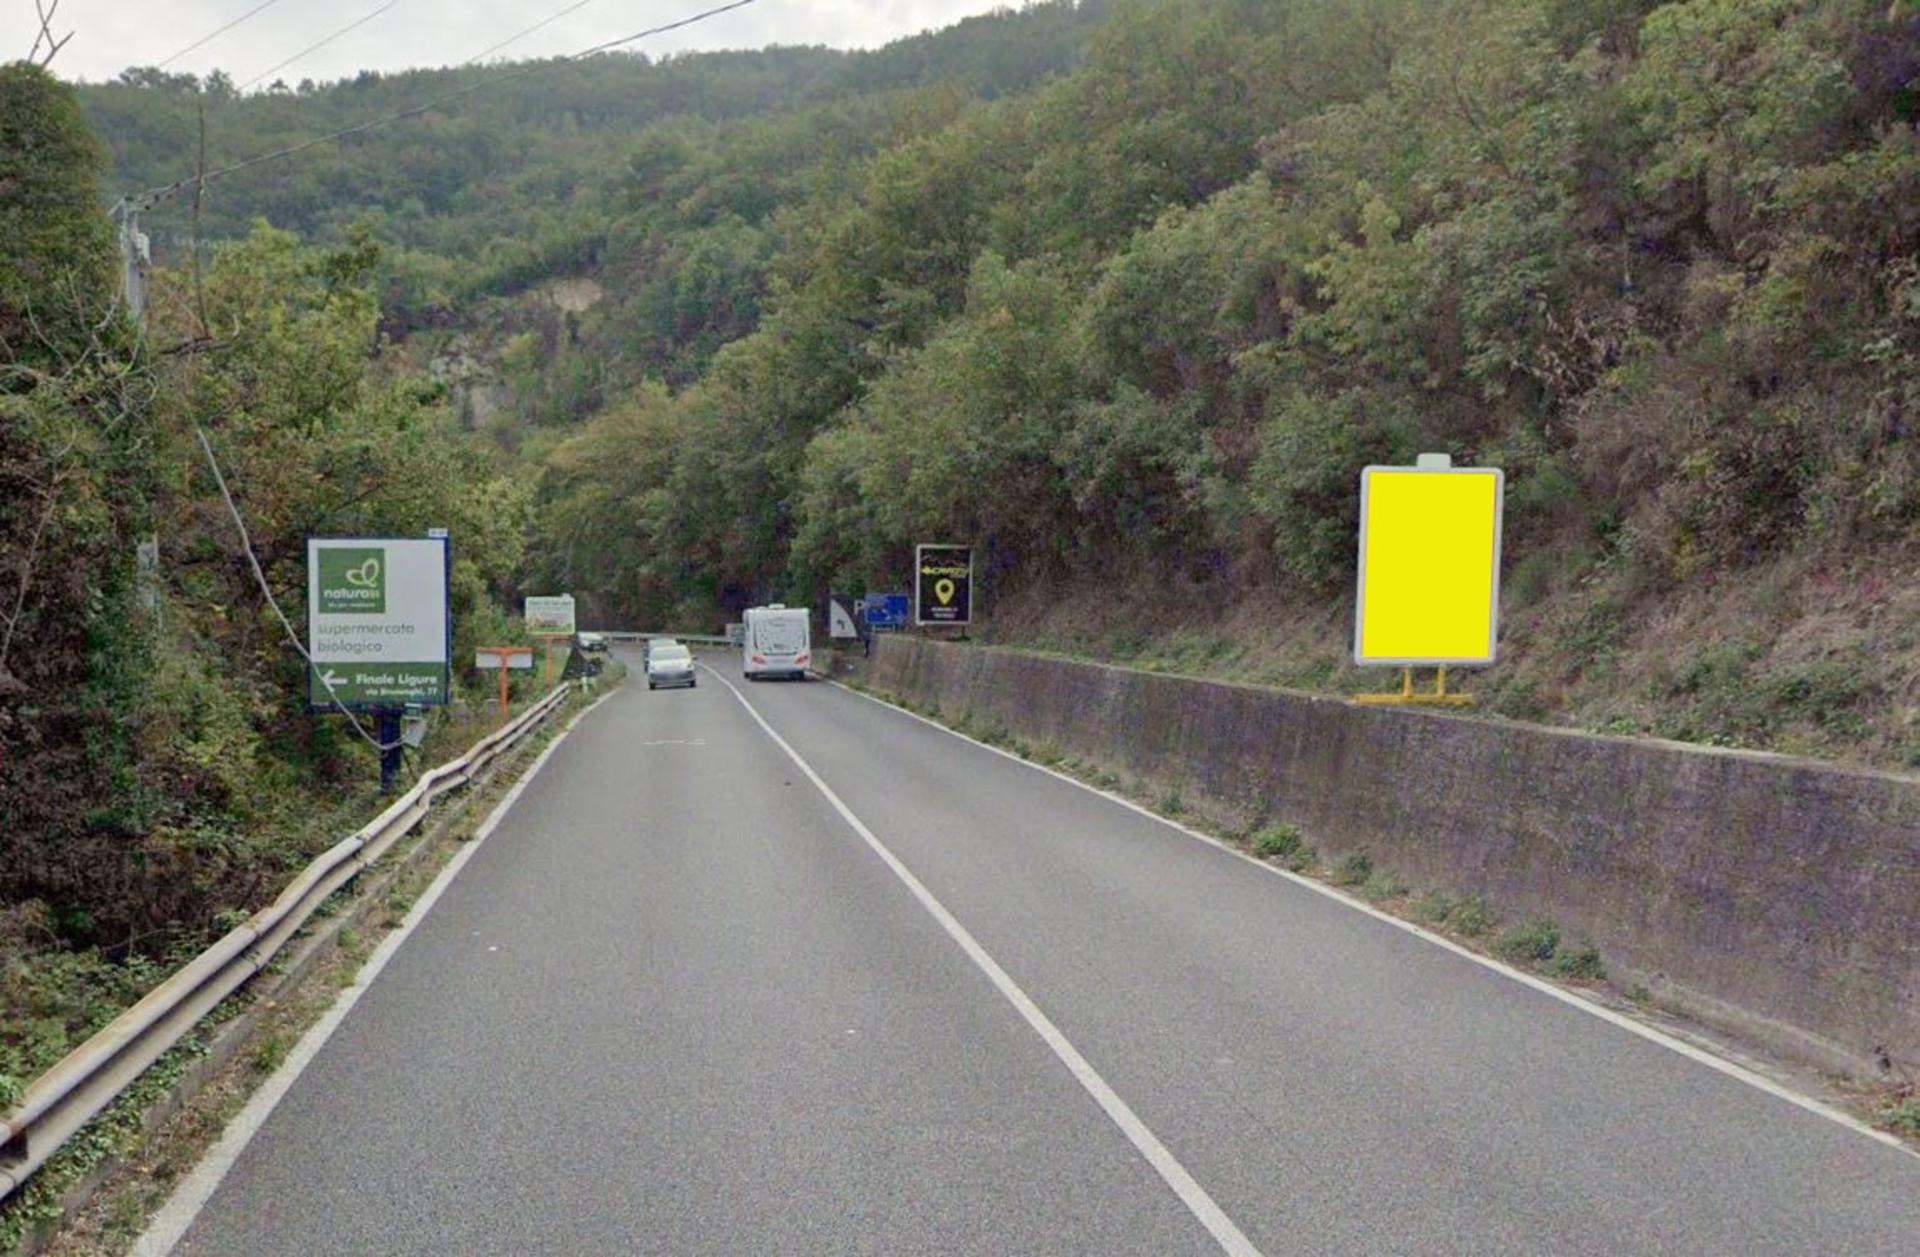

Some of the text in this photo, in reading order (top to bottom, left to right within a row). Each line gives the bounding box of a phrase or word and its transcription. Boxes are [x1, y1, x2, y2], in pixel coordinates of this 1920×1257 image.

[319, 624, 415, 635] supermercato
[318, 639, 382, 654] biologico
[355, 673, 438, 686] Finale Ligure
